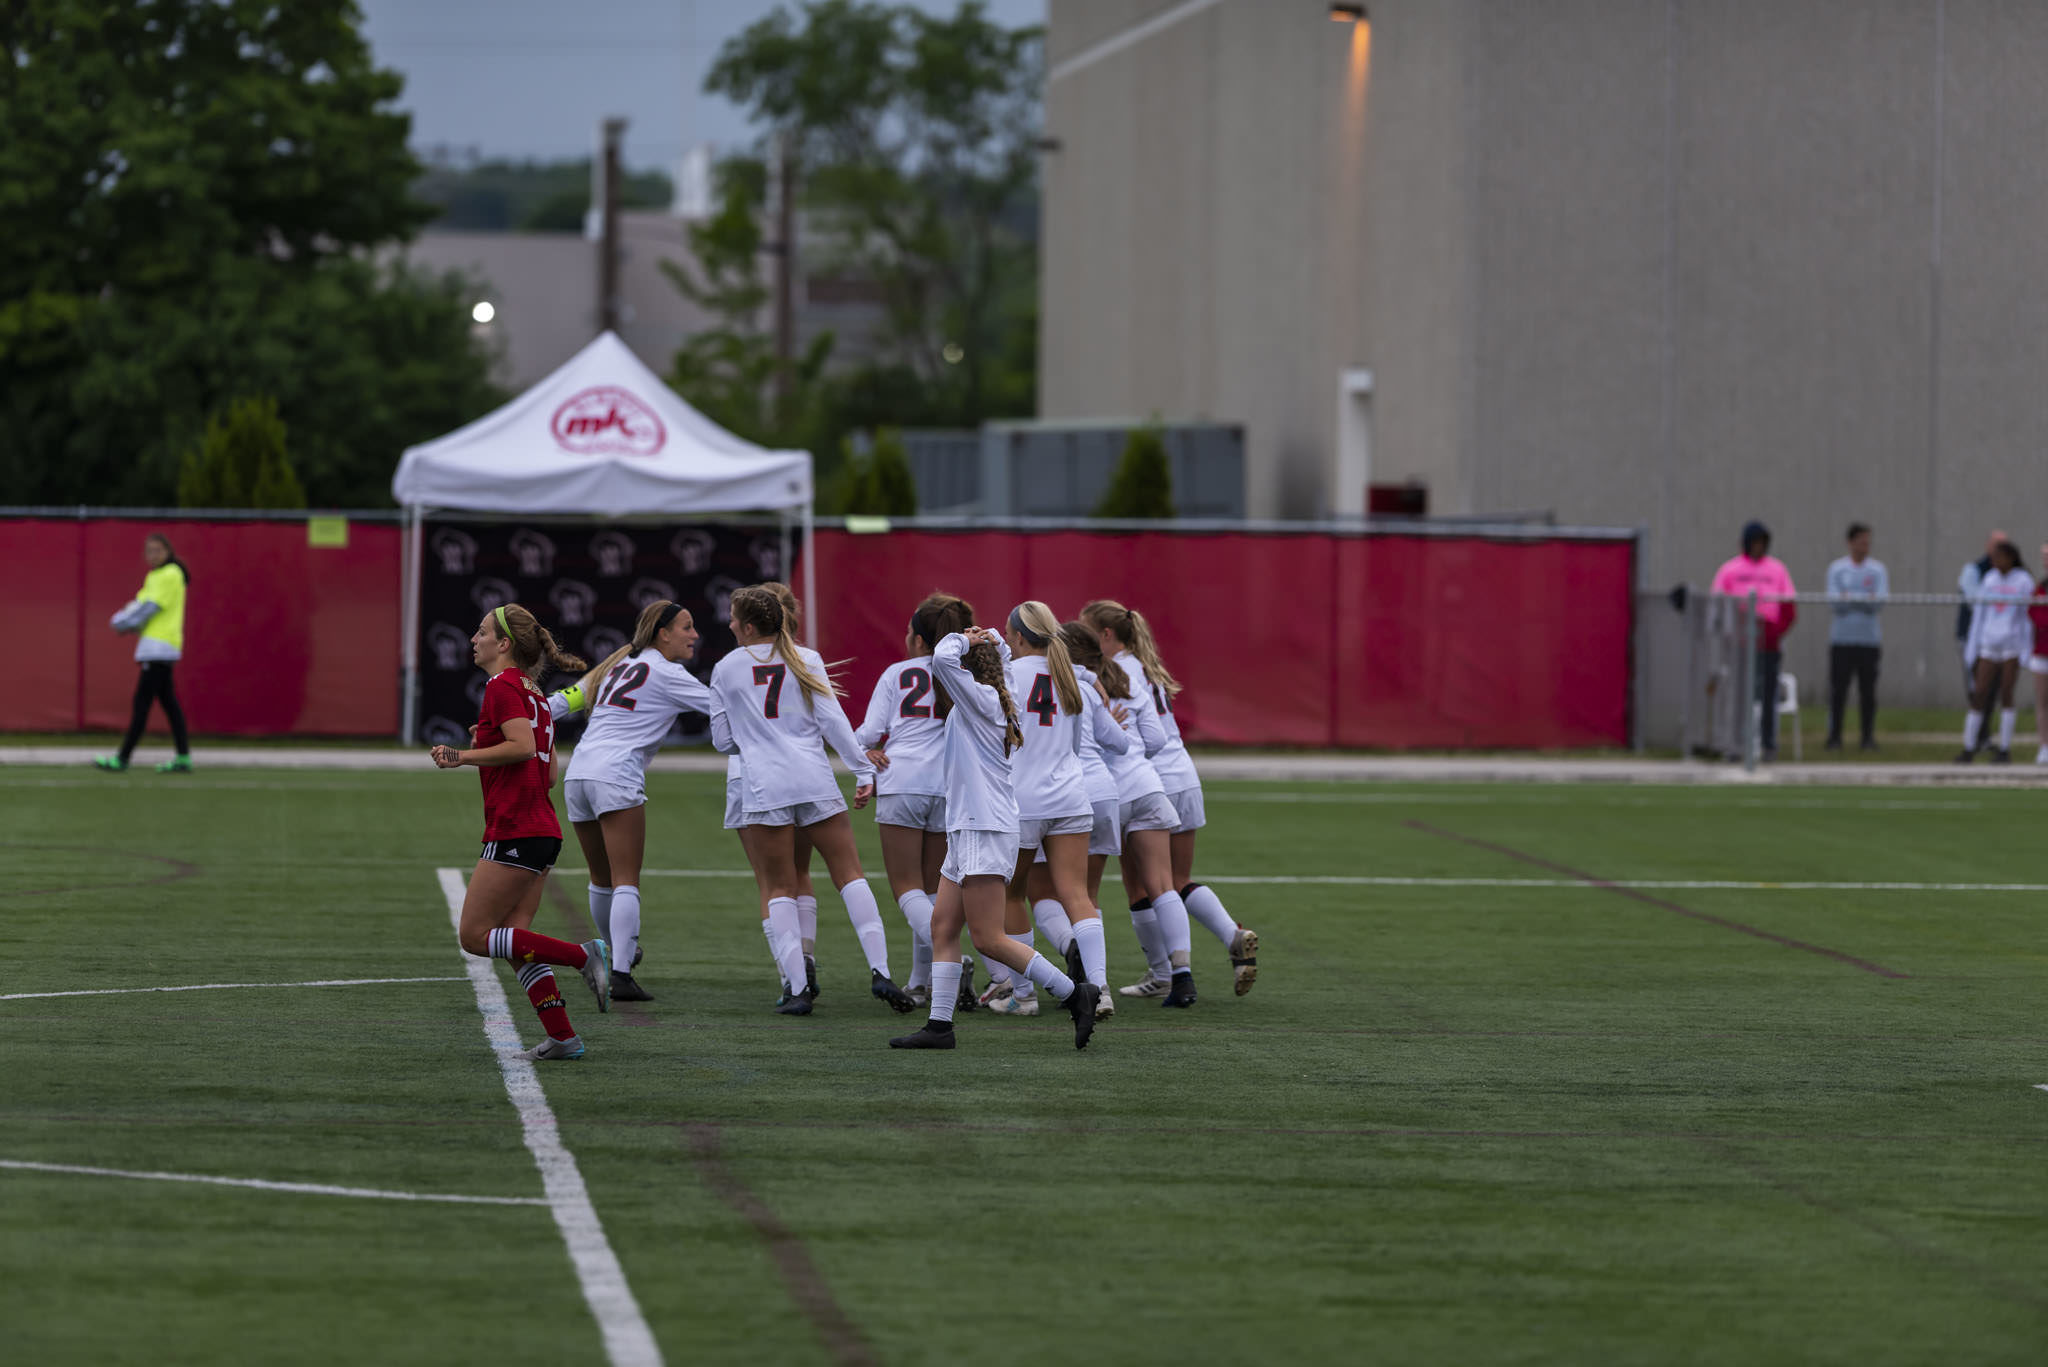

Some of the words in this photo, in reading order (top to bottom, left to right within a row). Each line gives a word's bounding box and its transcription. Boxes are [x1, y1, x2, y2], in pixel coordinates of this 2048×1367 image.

[597, 662, 650, 711] 12
[752, 664, 786, 719] 7
[1027, 673, 1057, 726] 4
